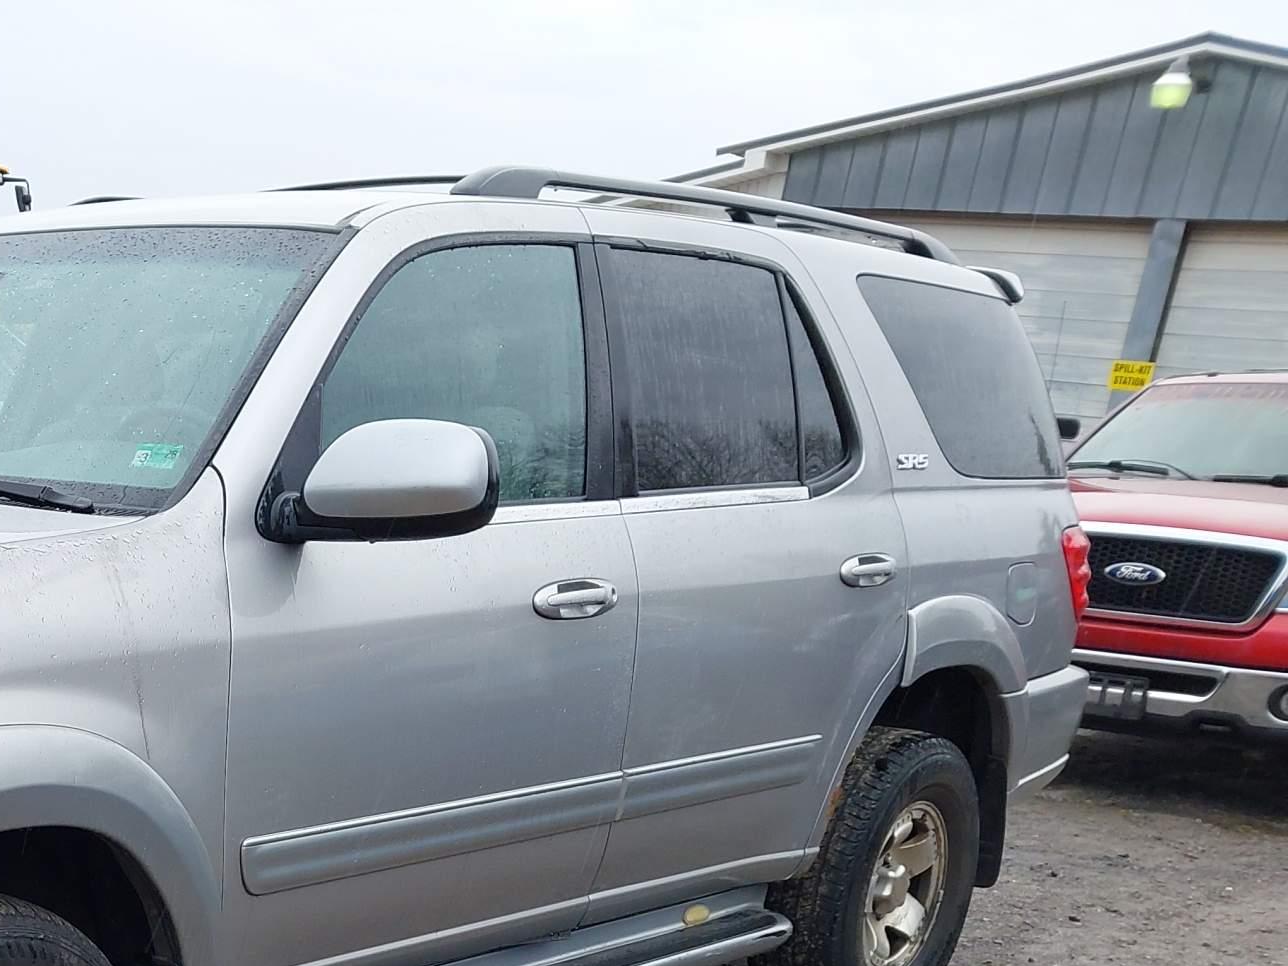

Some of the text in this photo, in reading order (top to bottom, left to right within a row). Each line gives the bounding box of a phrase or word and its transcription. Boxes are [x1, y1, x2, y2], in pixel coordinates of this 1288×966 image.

[1112, 363, 1153, 375] SPILL-KIT
[1113, 376, 1145, 386] STATION
[896, 454, 929, 470] SR5
[1116, 565, 1152, 580] Ford
